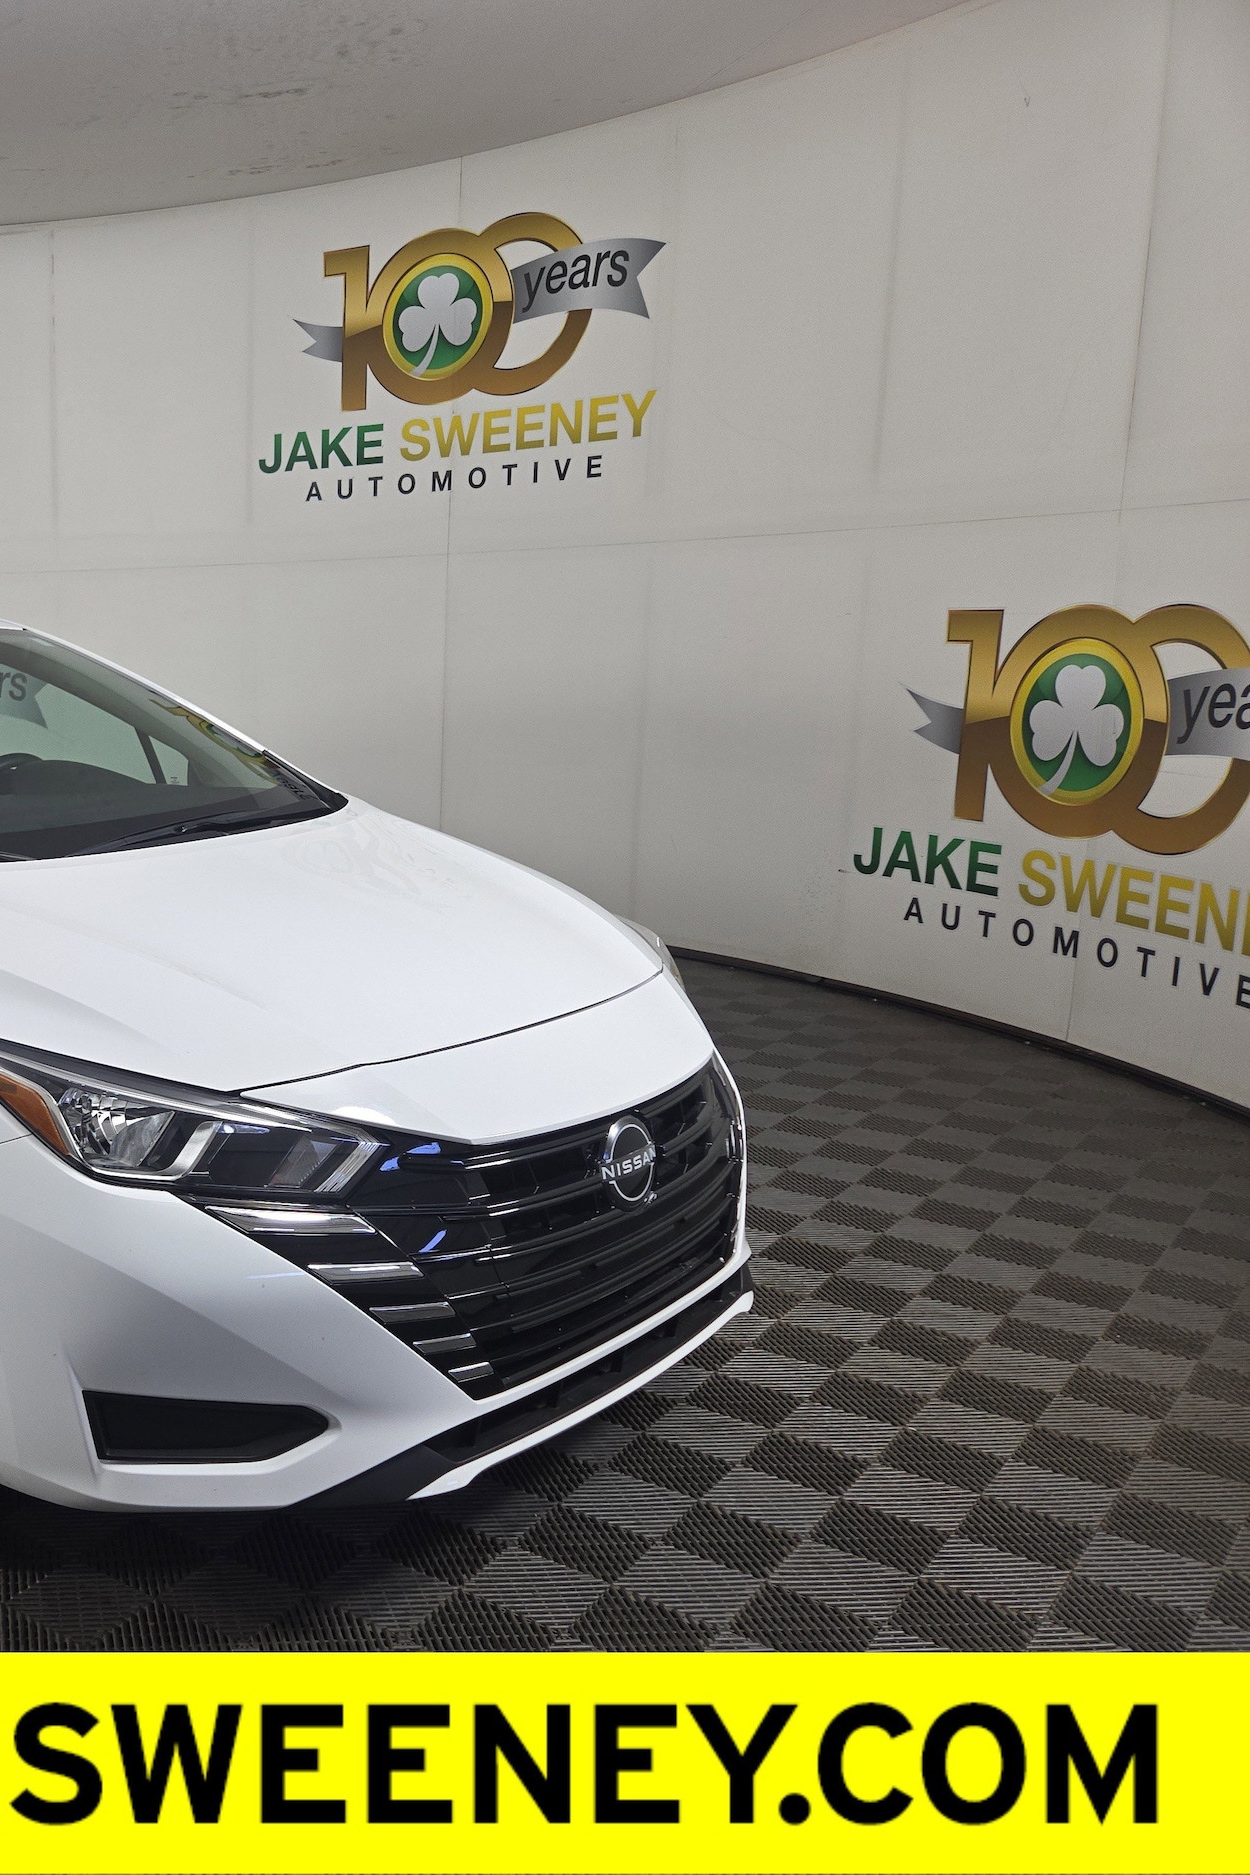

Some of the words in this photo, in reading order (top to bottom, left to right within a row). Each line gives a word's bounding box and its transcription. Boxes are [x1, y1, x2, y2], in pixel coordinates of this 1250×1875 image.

[522, 249, 630, 313] years
[258, 423, 385, 474] JAKE
[399, 390, 658, 463] SWEENEY
[305, 455, 603, 502] AUTOMOTIVE
[853, 826, 1002, 897] JAKE
[1018, 849, 1250, 958] SWEEN
[904, 897, 1250, 1010] AUTOMOTIVE
[601, 1146, 657, 1180] NISSAN
